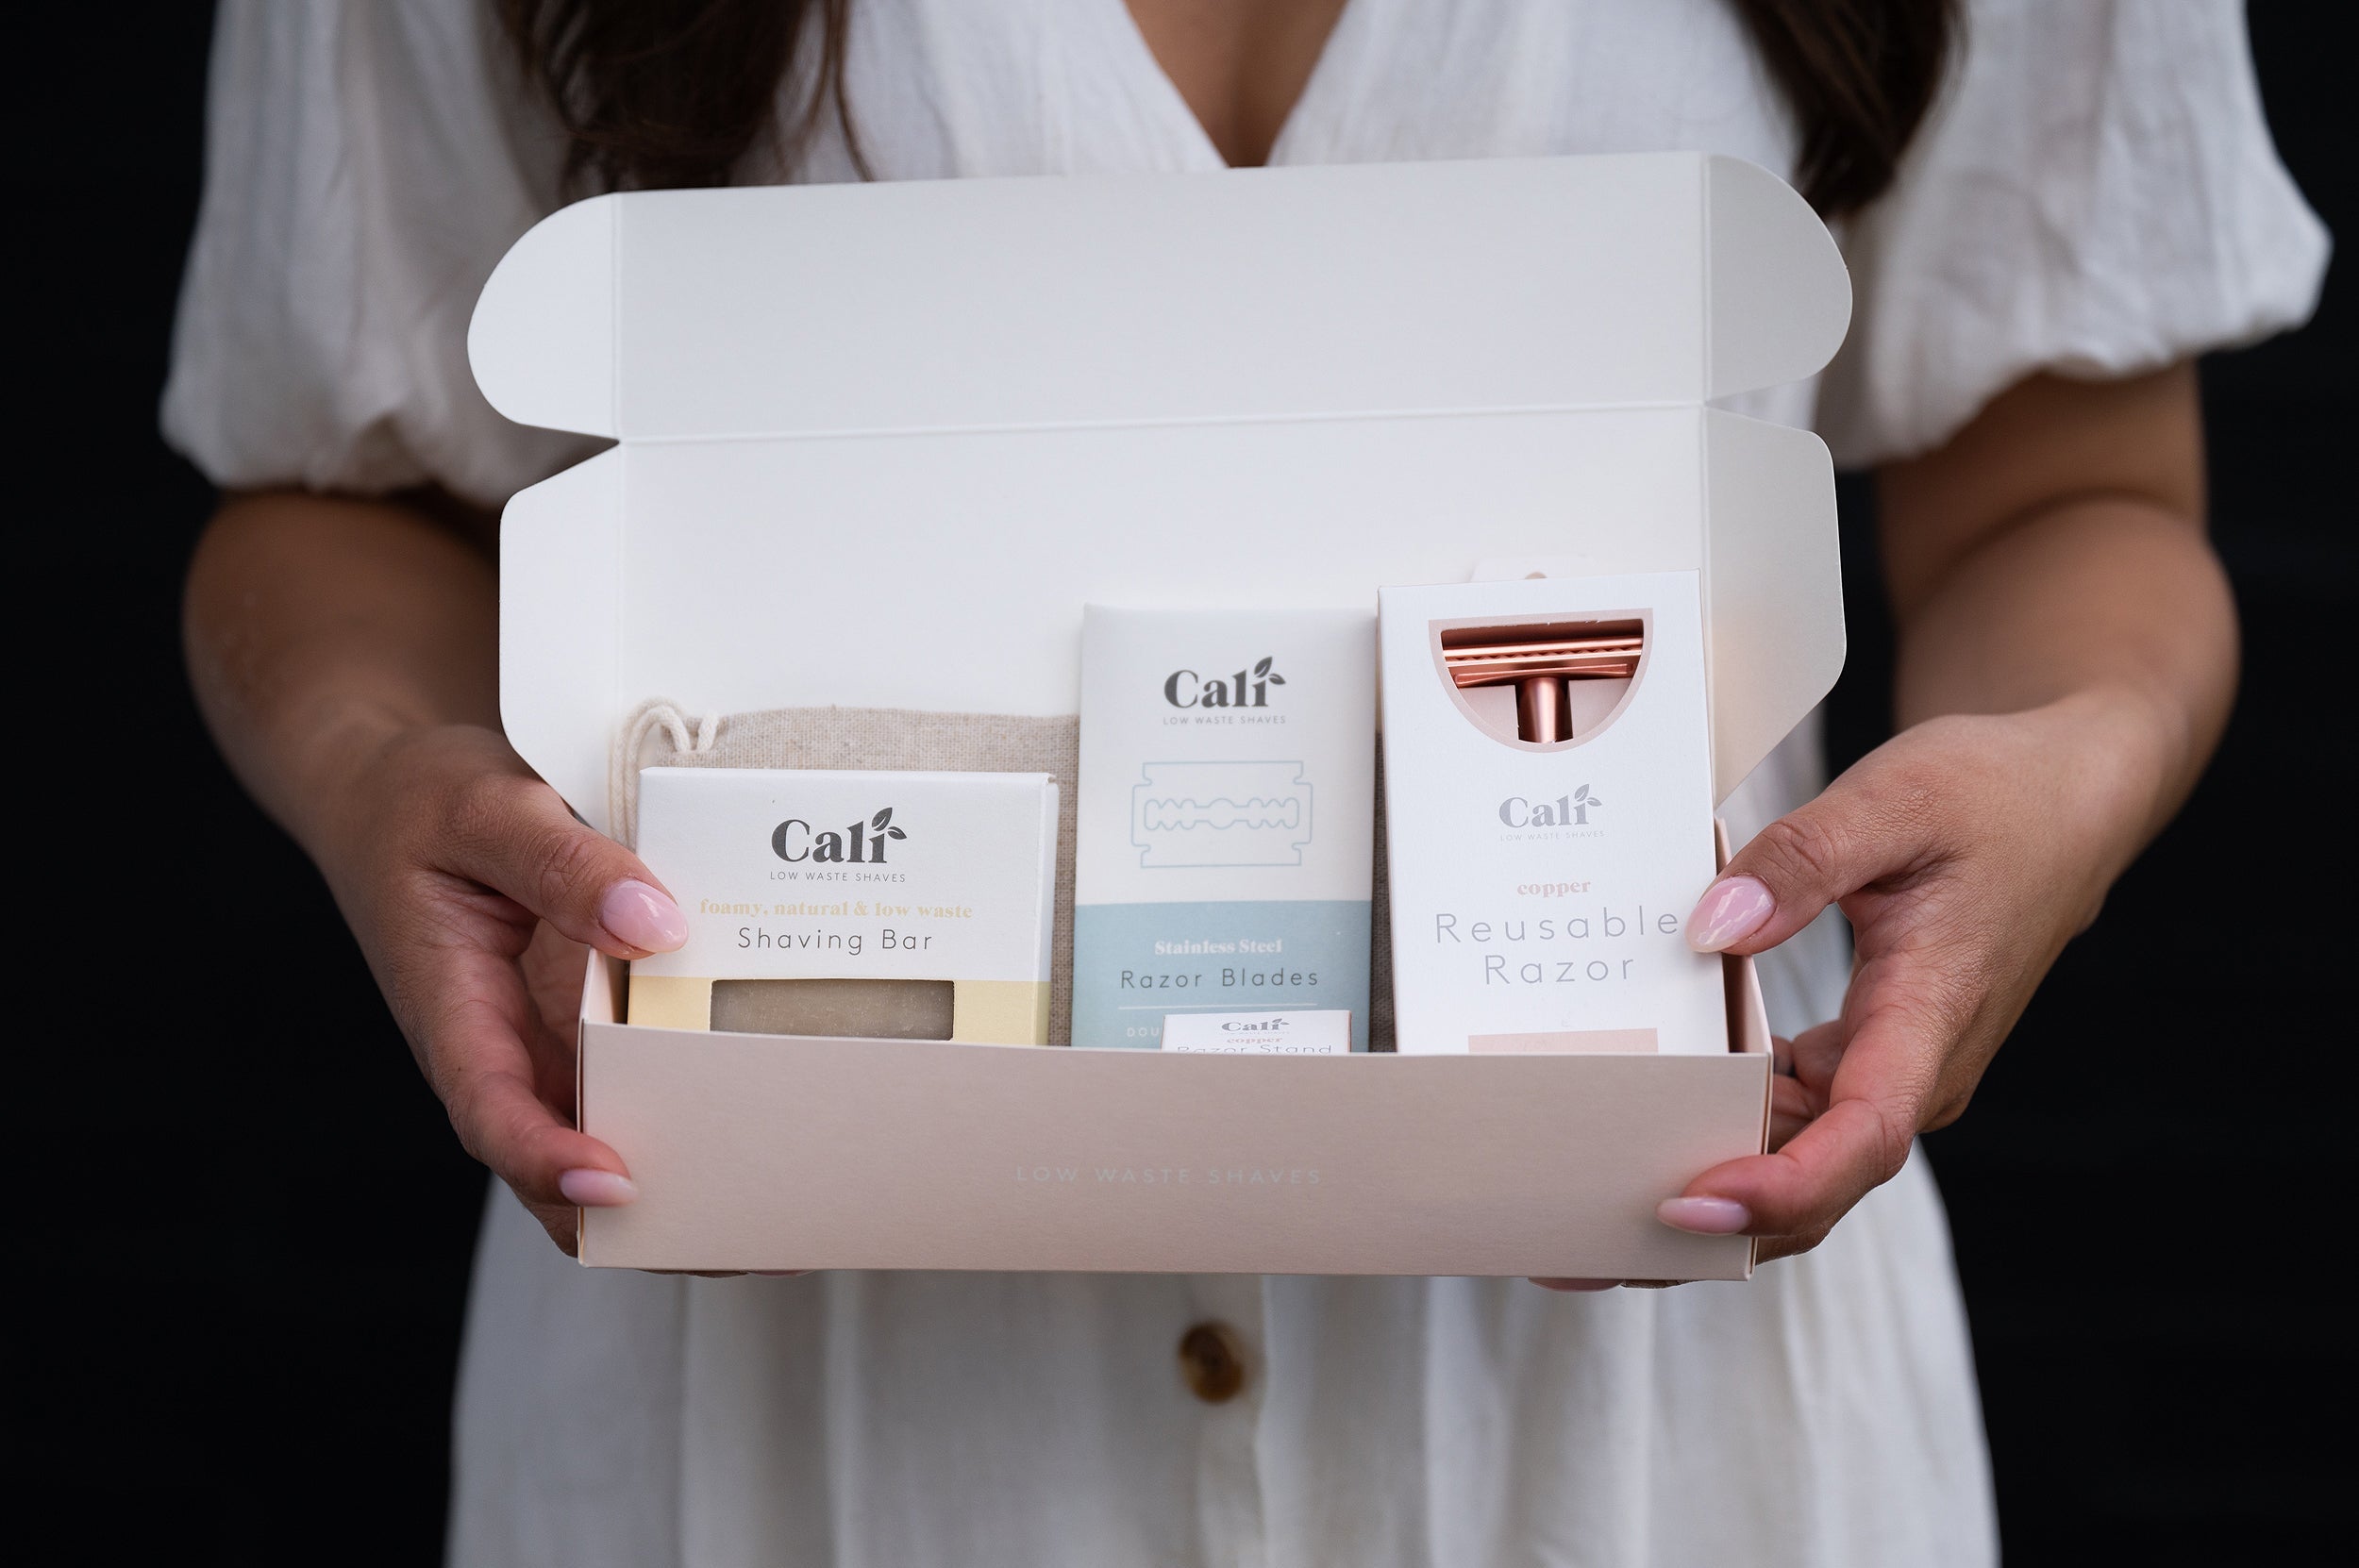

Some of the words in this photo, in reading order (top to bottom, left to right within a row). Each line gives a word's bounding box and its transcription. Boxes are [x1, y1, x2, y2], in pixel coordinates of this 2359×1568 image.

[1164, 657, 1286, 709] Cali
[1163, 716, 1189, 726] LOW
[1196, 716, 1233, 725] WASTE
[1241, 715, 1286, 725] SHAVES
[1498, 783, 1602, 828] Cali
[771, 807, 908, 863] Cali
[770, 871, 798, 880] LOW
[805, 872, 847, 882] WASTE
[855, 873, 906, 883] SHAVES
[1516, 881, 1591, 898] copper
[700, 898, 768, 917] foamy,
[774, 900, 848, 916] natural
[853, 901, 869, 916] &
[875, 902, 910, 918] low
[917, 905, 973, 919] waste
[1435, 906, 1679, 943] Reusable
[737, 926, 862, 956] Shaving
[881, 929, 932, 950] Bar
[1154, 940, 1235, 955] Stainless
[1239, 939, 1282, 953] Steel
[1121, 971, 1202, 989] Razor
[1222, 968, 1318, 987] Blades
[1484, 955, 1634, 985] Razor
[1221, 1018, 1290, 1032] Cali
[1016, 1167, 1078, 1182] LOW
[1095, 1169, 1190, 1183] WASTE
[1208, 1170, 1320, 1184] SHAVES
